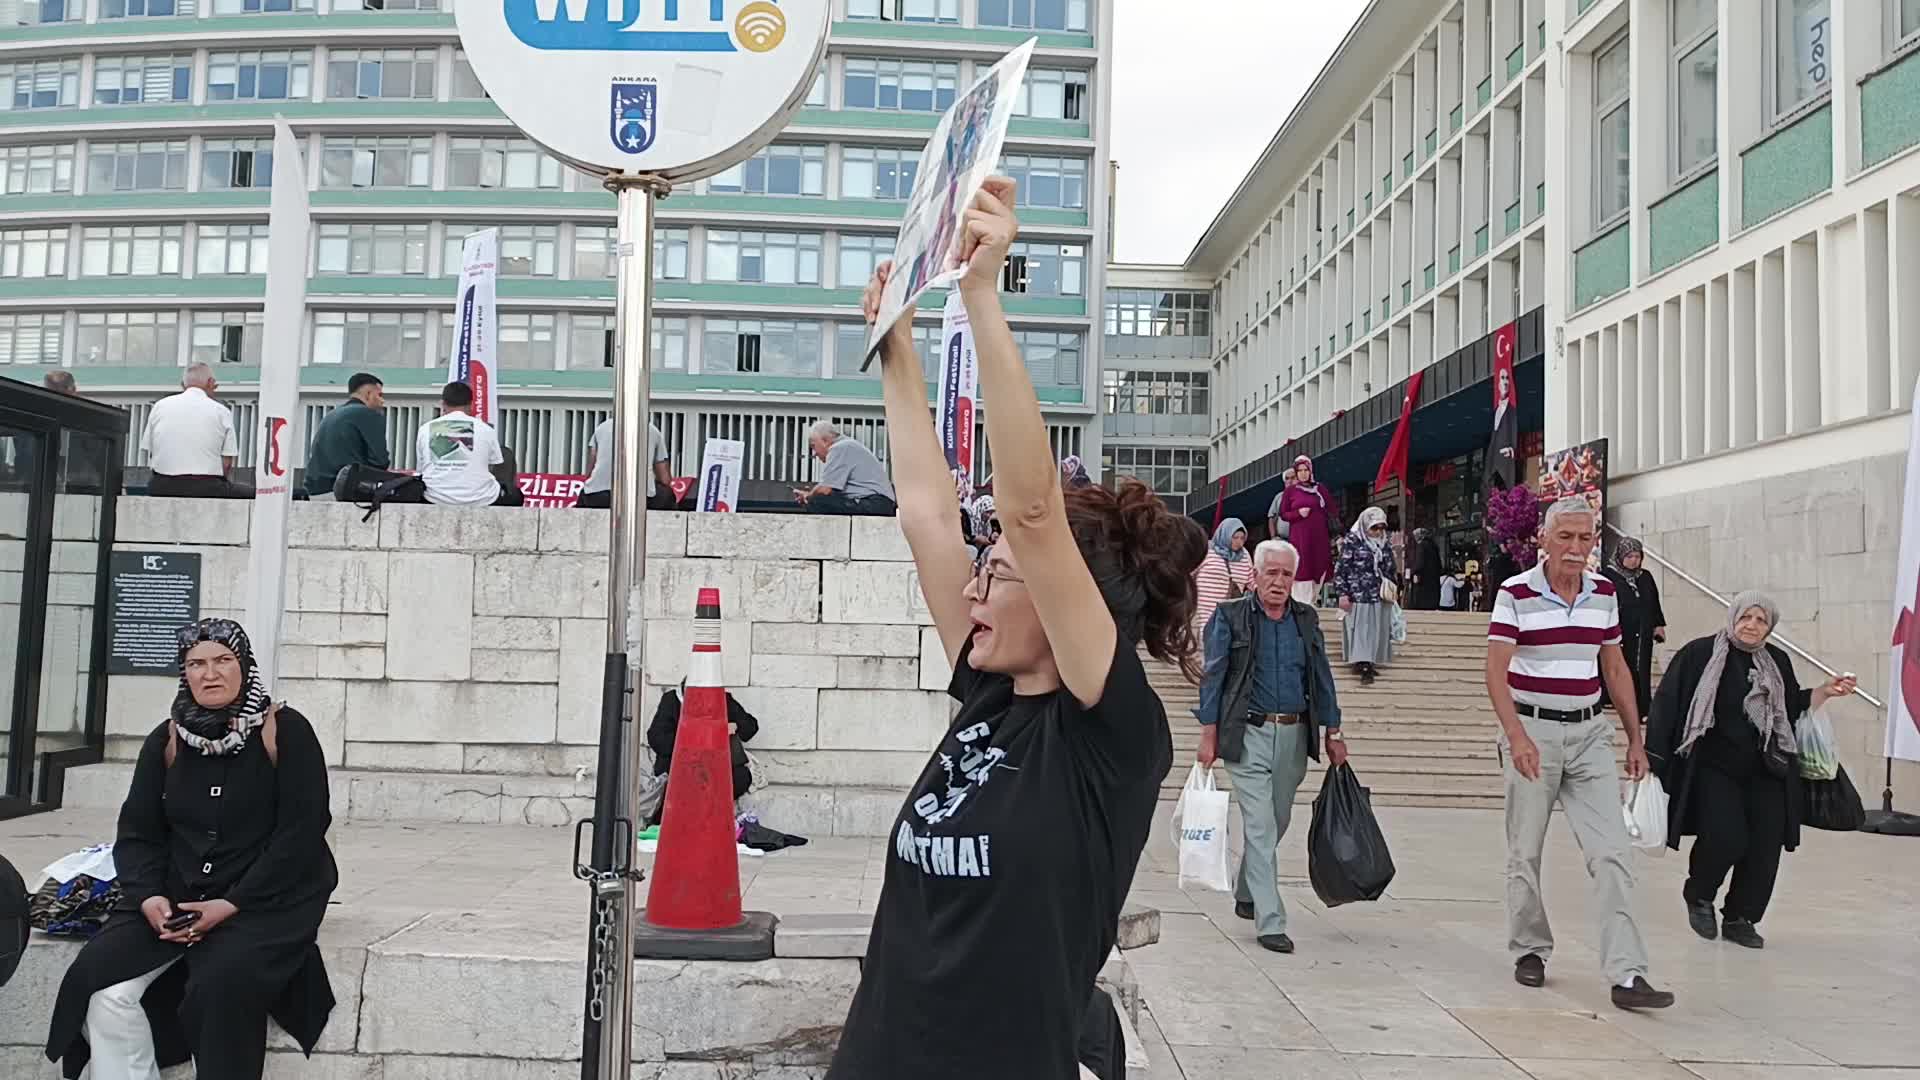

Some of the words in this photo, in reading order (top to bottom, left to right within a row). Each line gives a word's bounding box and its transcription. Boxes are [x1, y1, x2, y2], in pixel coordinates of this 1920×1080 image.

[462, 300, 472, 352] Festivali
[950, 345, 959, 390] Festivali
[947, 416, 955, 449] Kültür
[962, 409, 970, 449] Ankara
